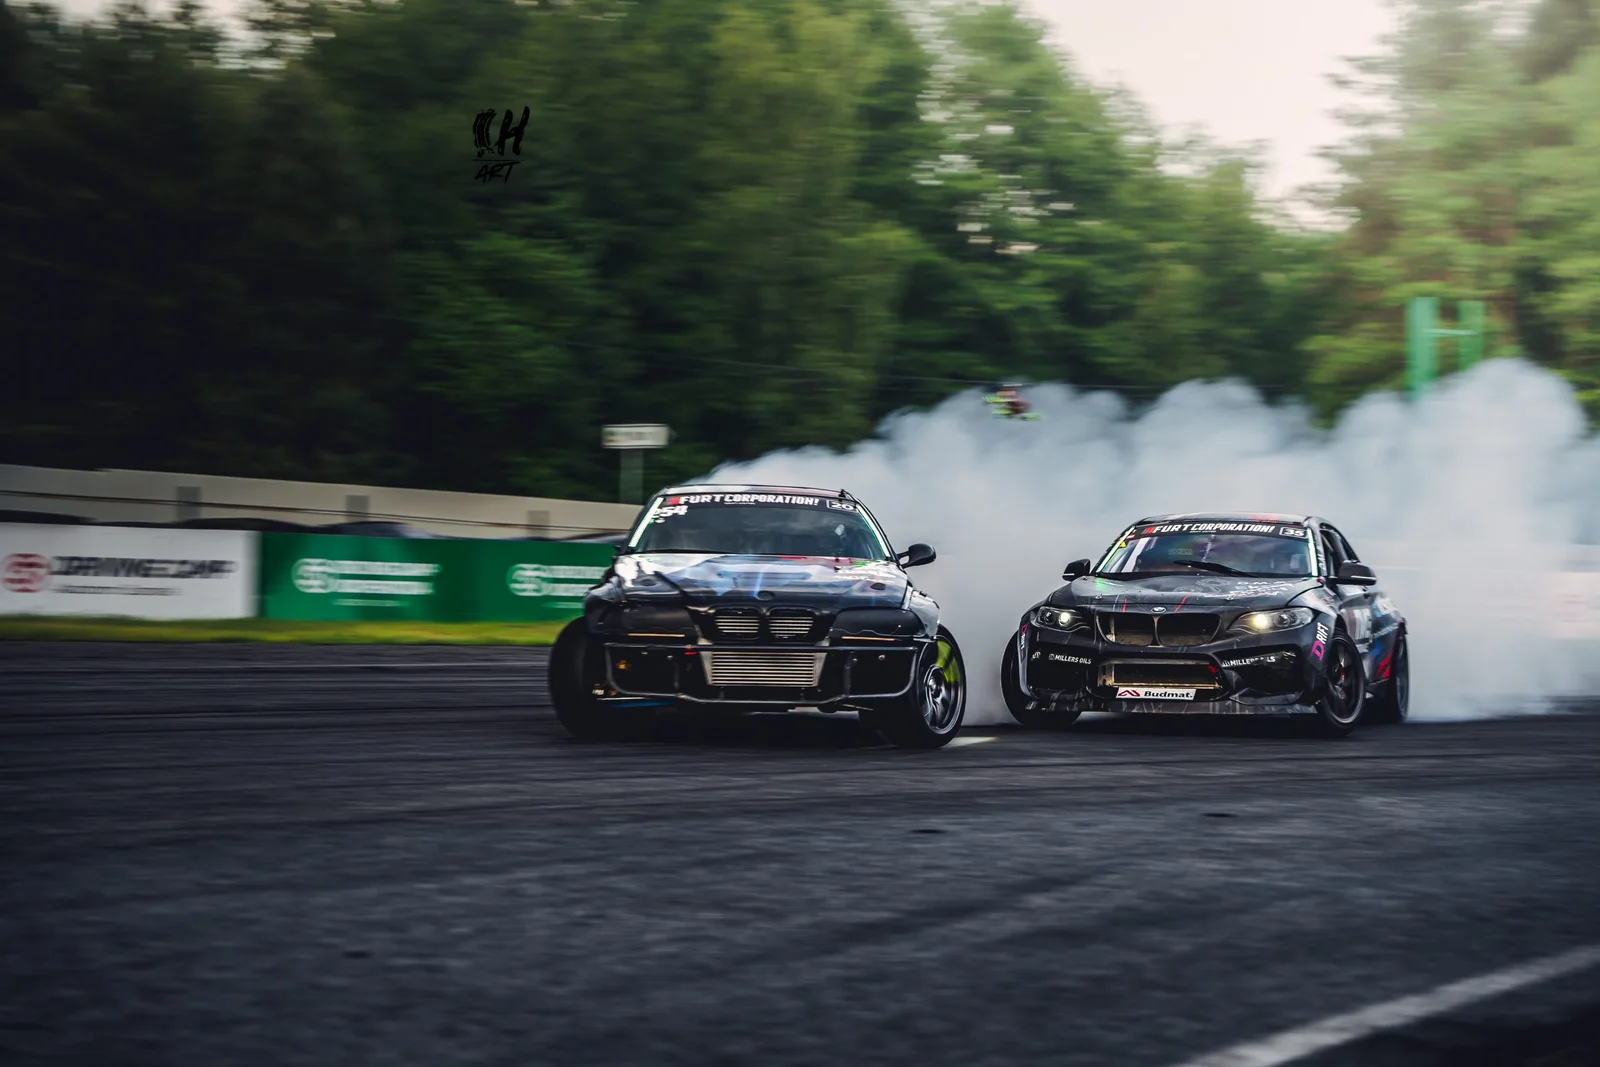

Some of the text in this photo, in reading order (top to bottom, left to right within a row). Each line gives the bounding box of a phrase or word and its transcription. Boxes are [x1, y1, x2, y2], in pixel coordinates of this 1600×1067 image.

[679, 494, 819, 506] FURT CORPORATION!
[1152, 523, 1276, 535] FURT CORPORATION!
[1284, 527, 1305, 537] 35
[1310, 622, 1329, 662] DRIFT
[1055, 654, 1092, 665] MILLERS OILS
[1143, 690, 1193, 699] Budmat.
